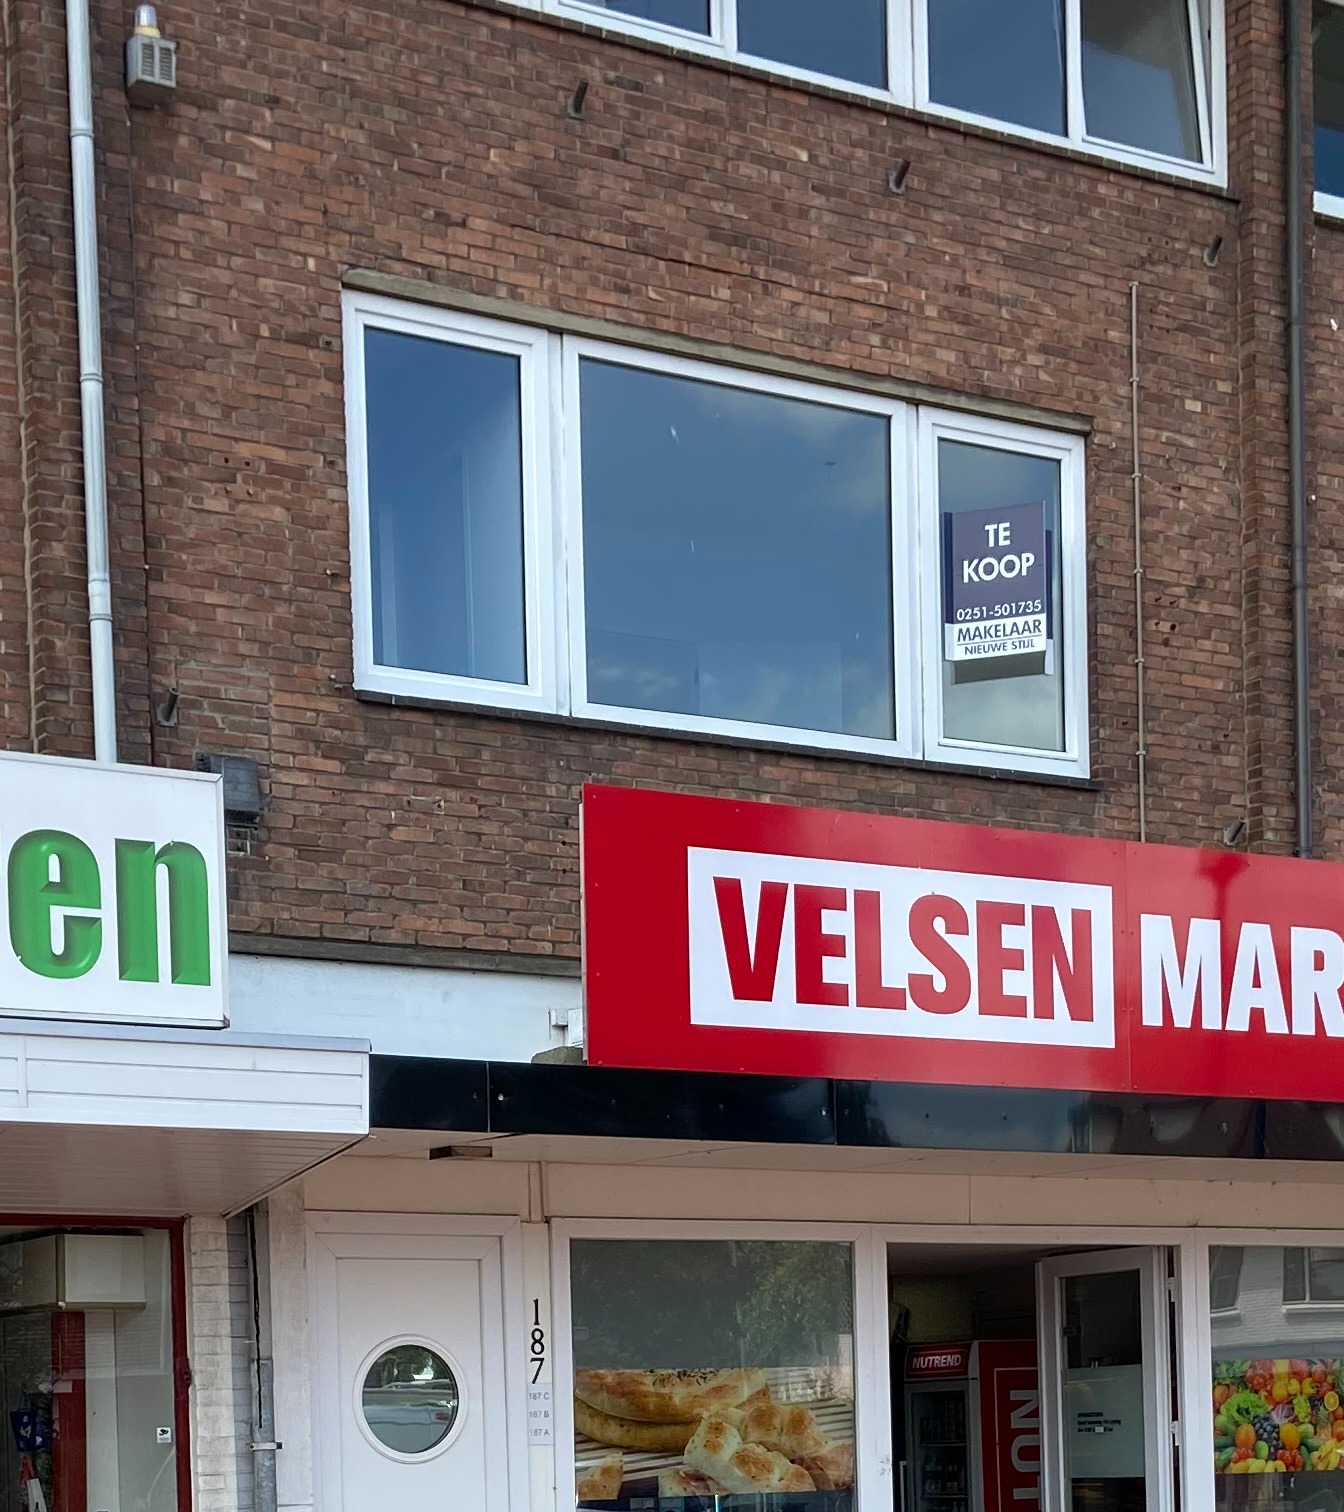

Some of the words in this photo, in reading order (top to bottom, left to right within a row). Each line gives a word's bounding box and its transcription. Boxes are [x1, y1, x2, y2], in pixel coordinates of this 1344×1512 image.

[984, 521, 1012, 549] TE
[962, 552, 1035, 584] KOOP
[956, 599, 1042, 622] 0251-501735
[957, 619, 1042, 643] MAKELAAR
[964, 641, 1008, 656] NIEUWE
[1011, 638, 1035, 651] STIJL
[712, 875, 1095, 1024] VELSEN
[530, 1298, 545, 1385] 187
[912, 1354, 962, 1369] NUTREND
